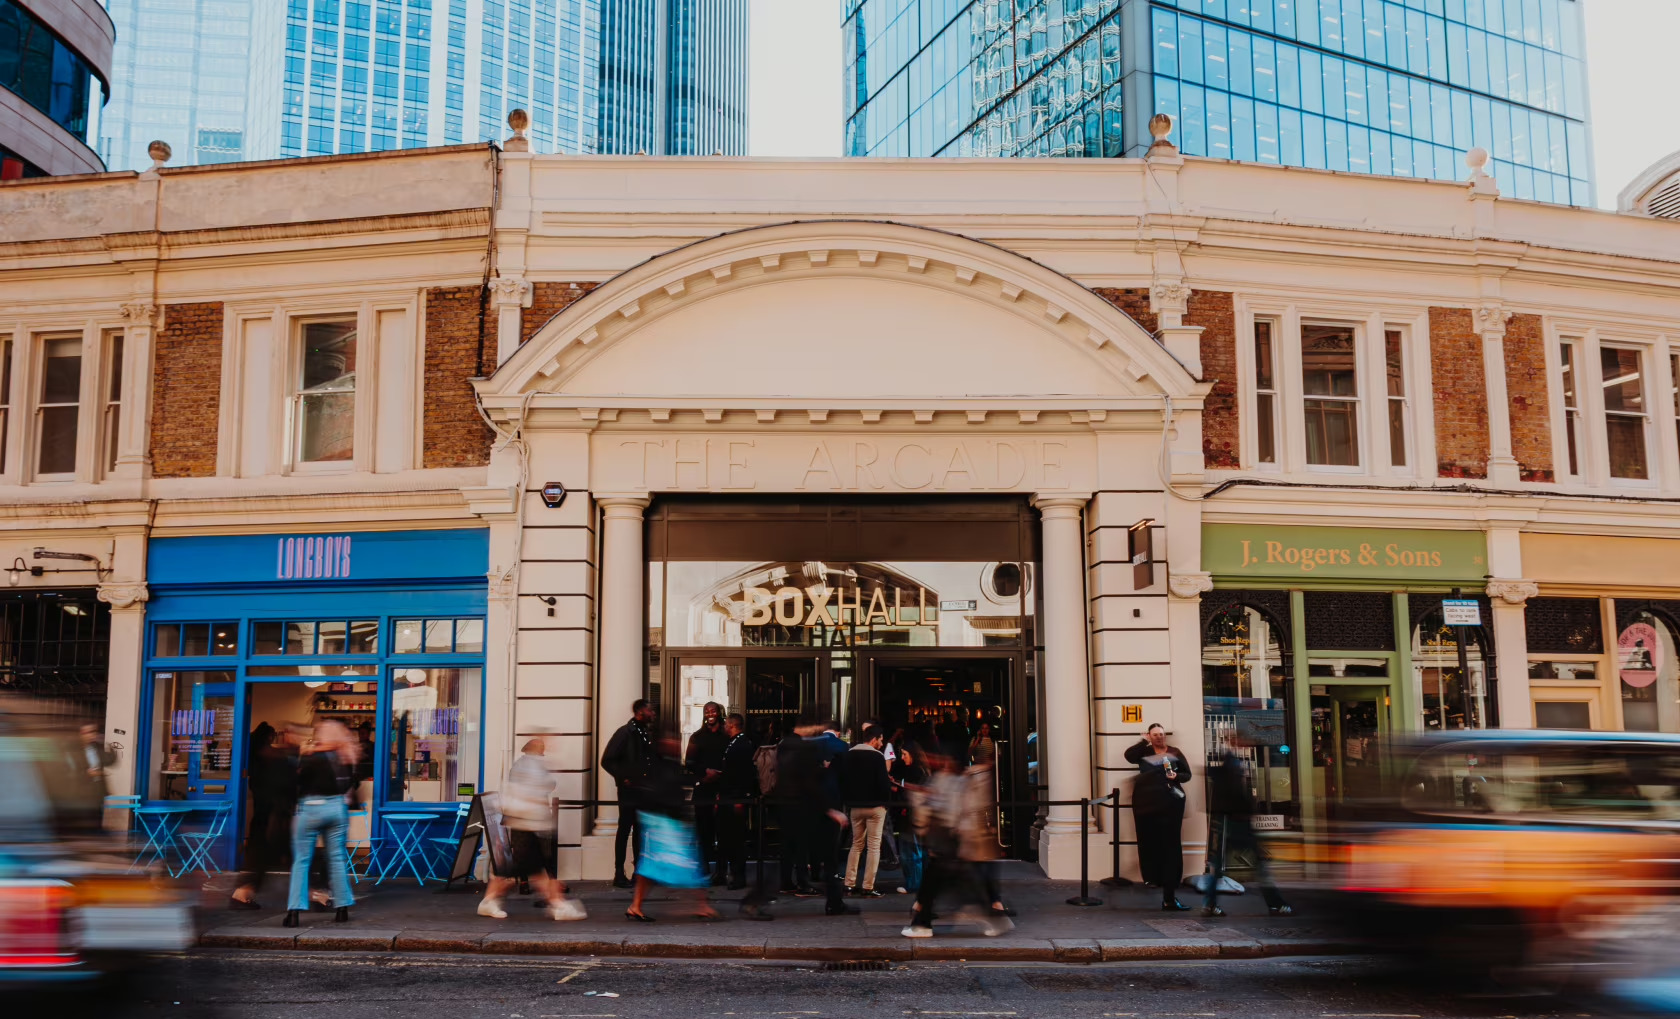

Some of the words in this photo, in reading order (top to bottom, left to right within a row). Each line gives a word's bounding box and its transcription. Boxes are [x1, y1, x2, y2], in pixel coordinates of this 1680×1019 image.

[619, 439, 756, 490] THE
[795, 439, 1071, 490] ARCADE
[276, 535, 351, 579] LONGBOYS
[1240, 540, 1258, 567] J.
[1265, 541, 1351, 571] Rogers
[1357, 543, 1379, 566] &
[1384, 543, 1442, 567] Sons
[743, 586, 940, 626] BOXHALL
[1220, 636, 1236, 644] Shoe
[171, 709, 216, 737] LONGBOYS
